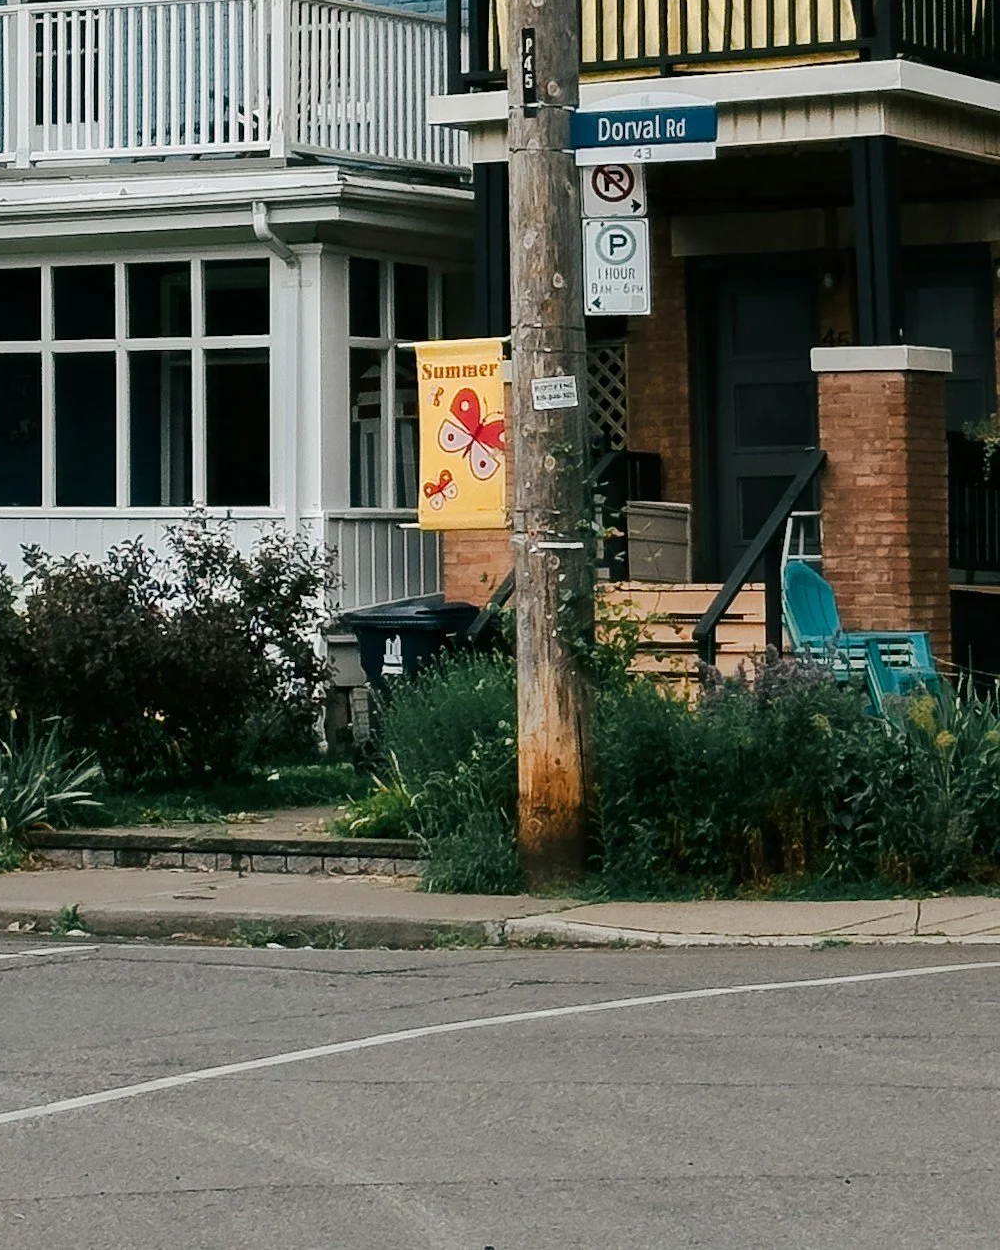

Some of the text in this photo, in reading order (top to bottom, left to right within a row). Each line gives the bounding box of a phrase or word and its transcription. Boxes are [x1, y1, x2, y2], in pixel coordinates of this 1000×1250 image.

[598, 114, 686, 141] Dorval Rd
[634, 148, 652, 159] 43
[609, 234, 628, 256] P
[605, 267, 635, 280] HOUR
[623, 282, 643, 294] 6PM
[421, 363, 499, 381] Summer
